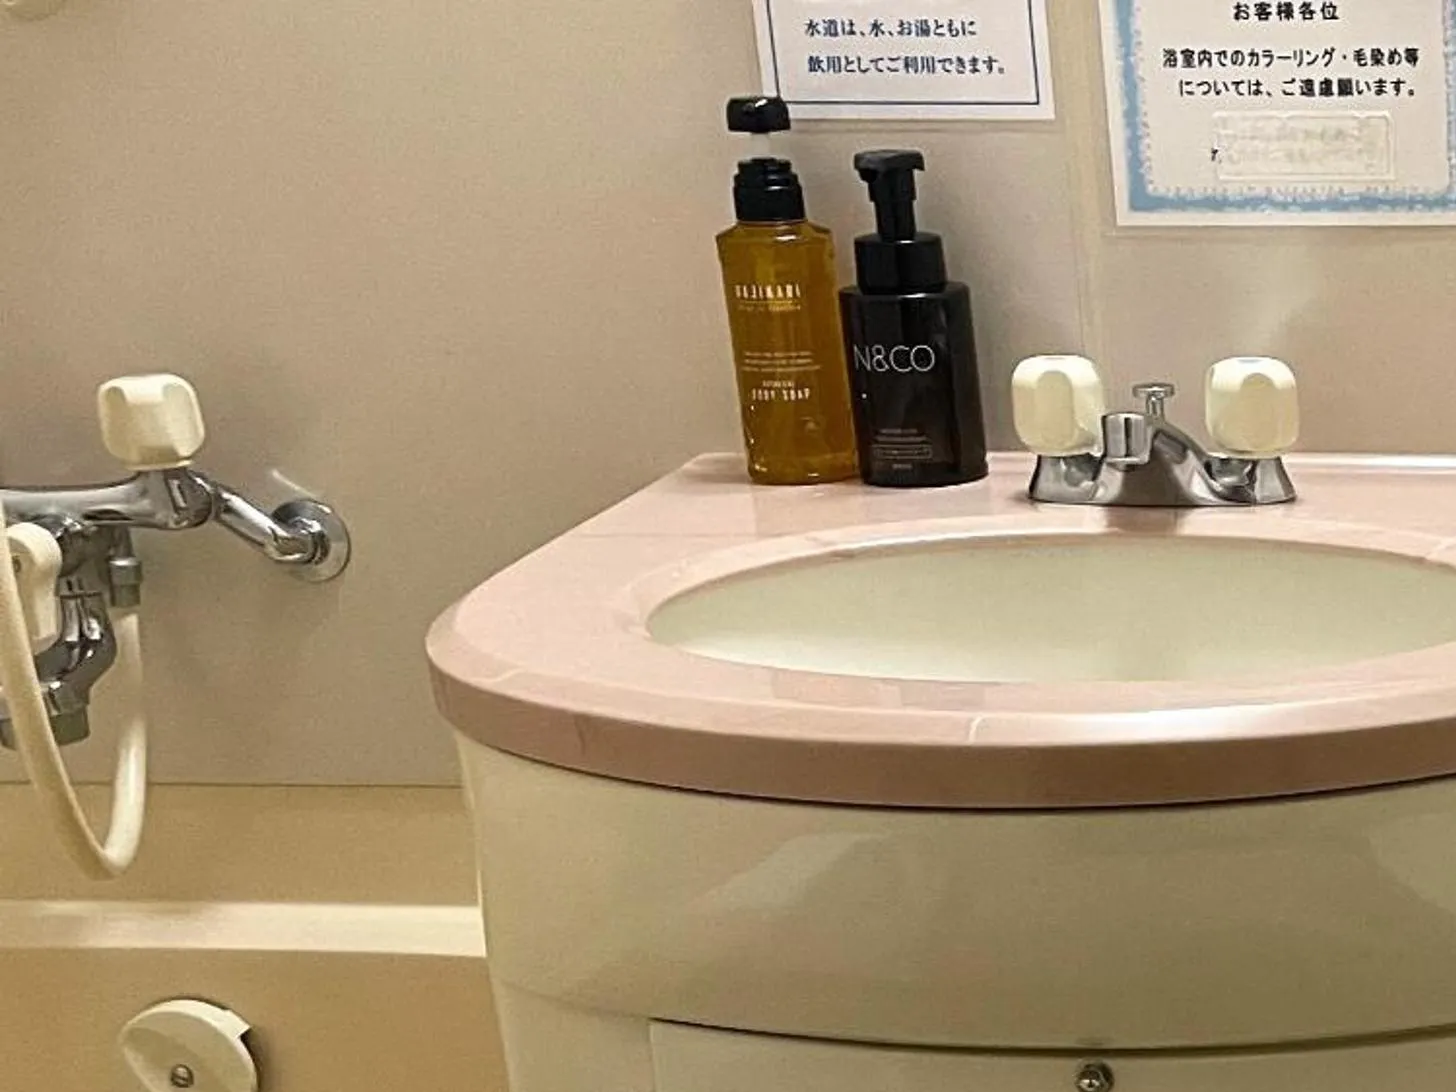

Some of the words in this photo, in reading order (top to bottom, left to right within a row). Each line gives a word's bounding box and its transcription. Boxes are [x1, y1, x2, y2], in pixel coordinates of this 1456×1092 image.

[1232, 1, 1340, 21] お客様各位
[804, 18, 977, 37] 水道は、水、お湯ともに
[807, 55, 1005, 74] 飲用としてご利用できます。
[853, 344, 935, 372] N&CO
